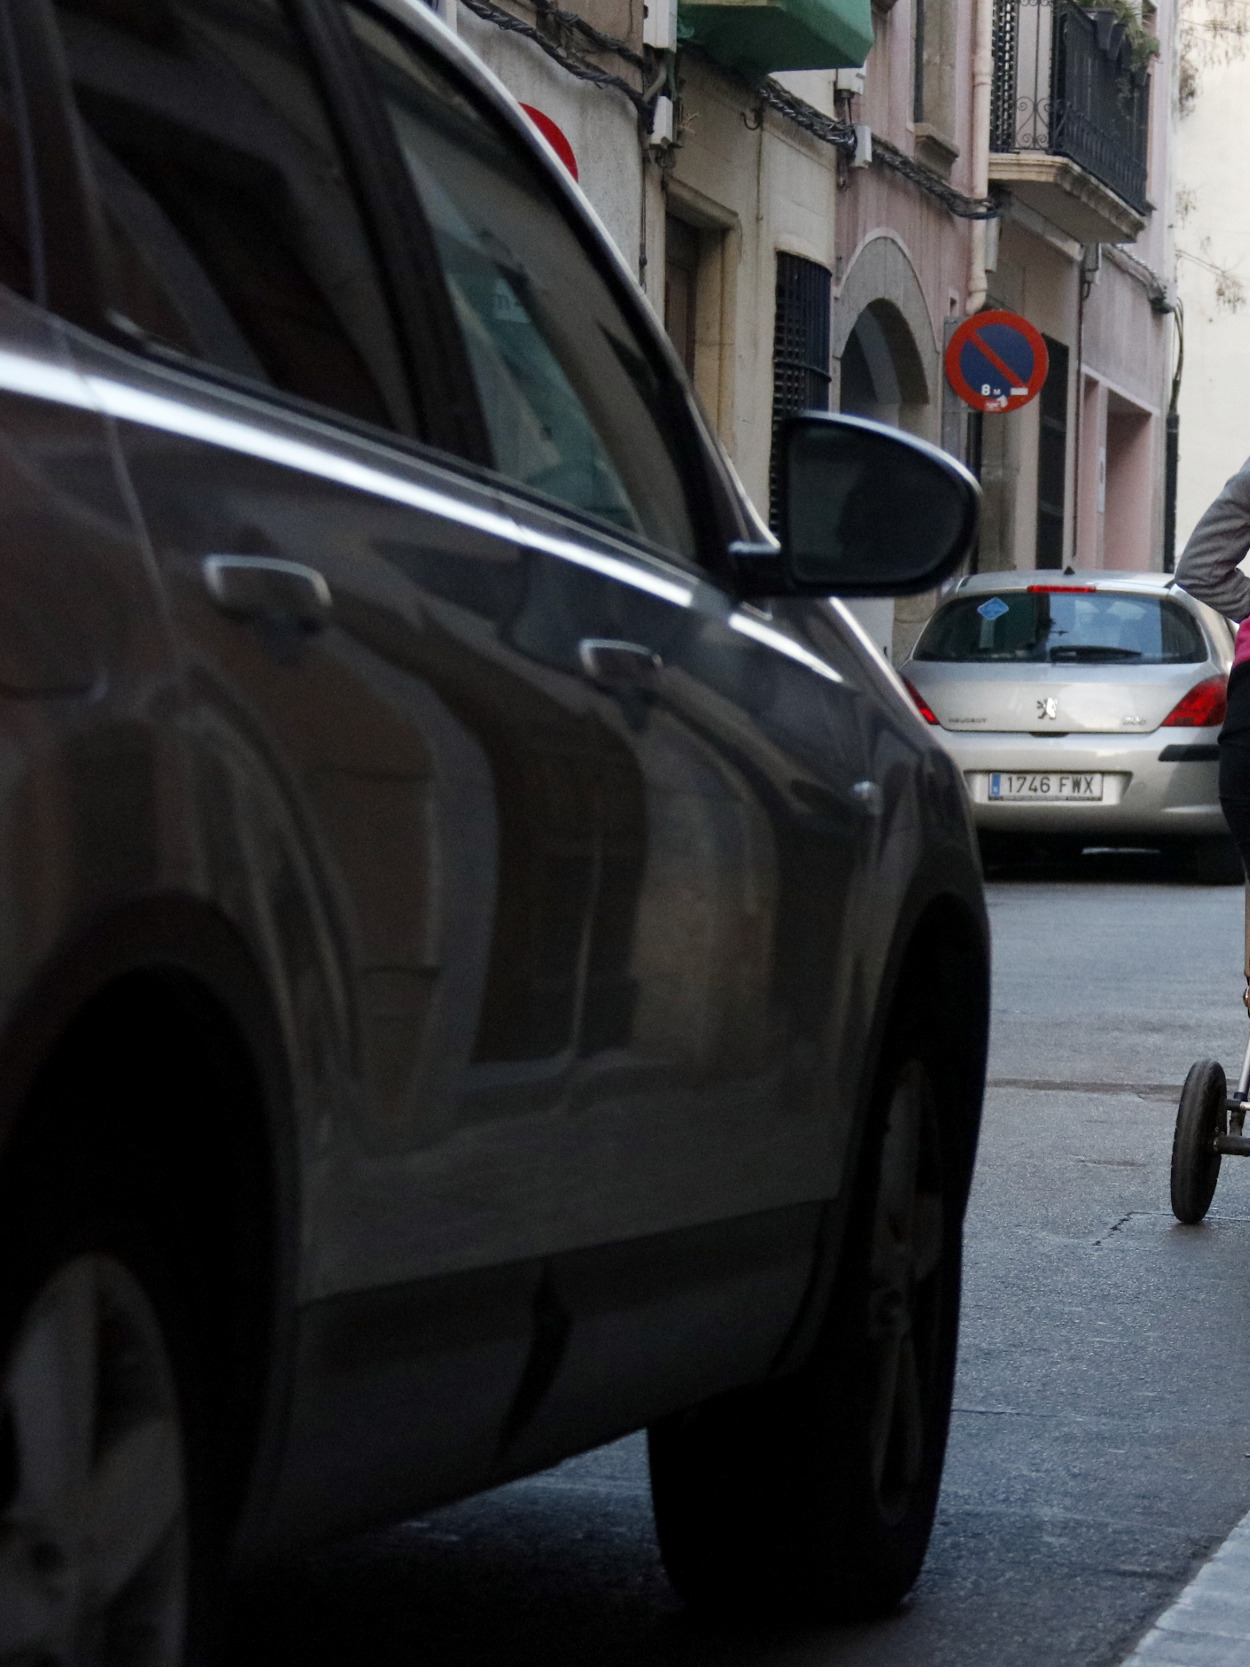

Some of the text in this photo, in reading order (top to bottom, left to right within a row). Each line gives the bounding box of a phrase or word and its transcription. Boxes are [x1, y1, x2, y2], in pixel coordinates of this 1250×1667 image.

[981, 384, 991, 396] 8
[1007, 776, 1051, 793] 1746
[1059, 776, 1094, 793] FWX
